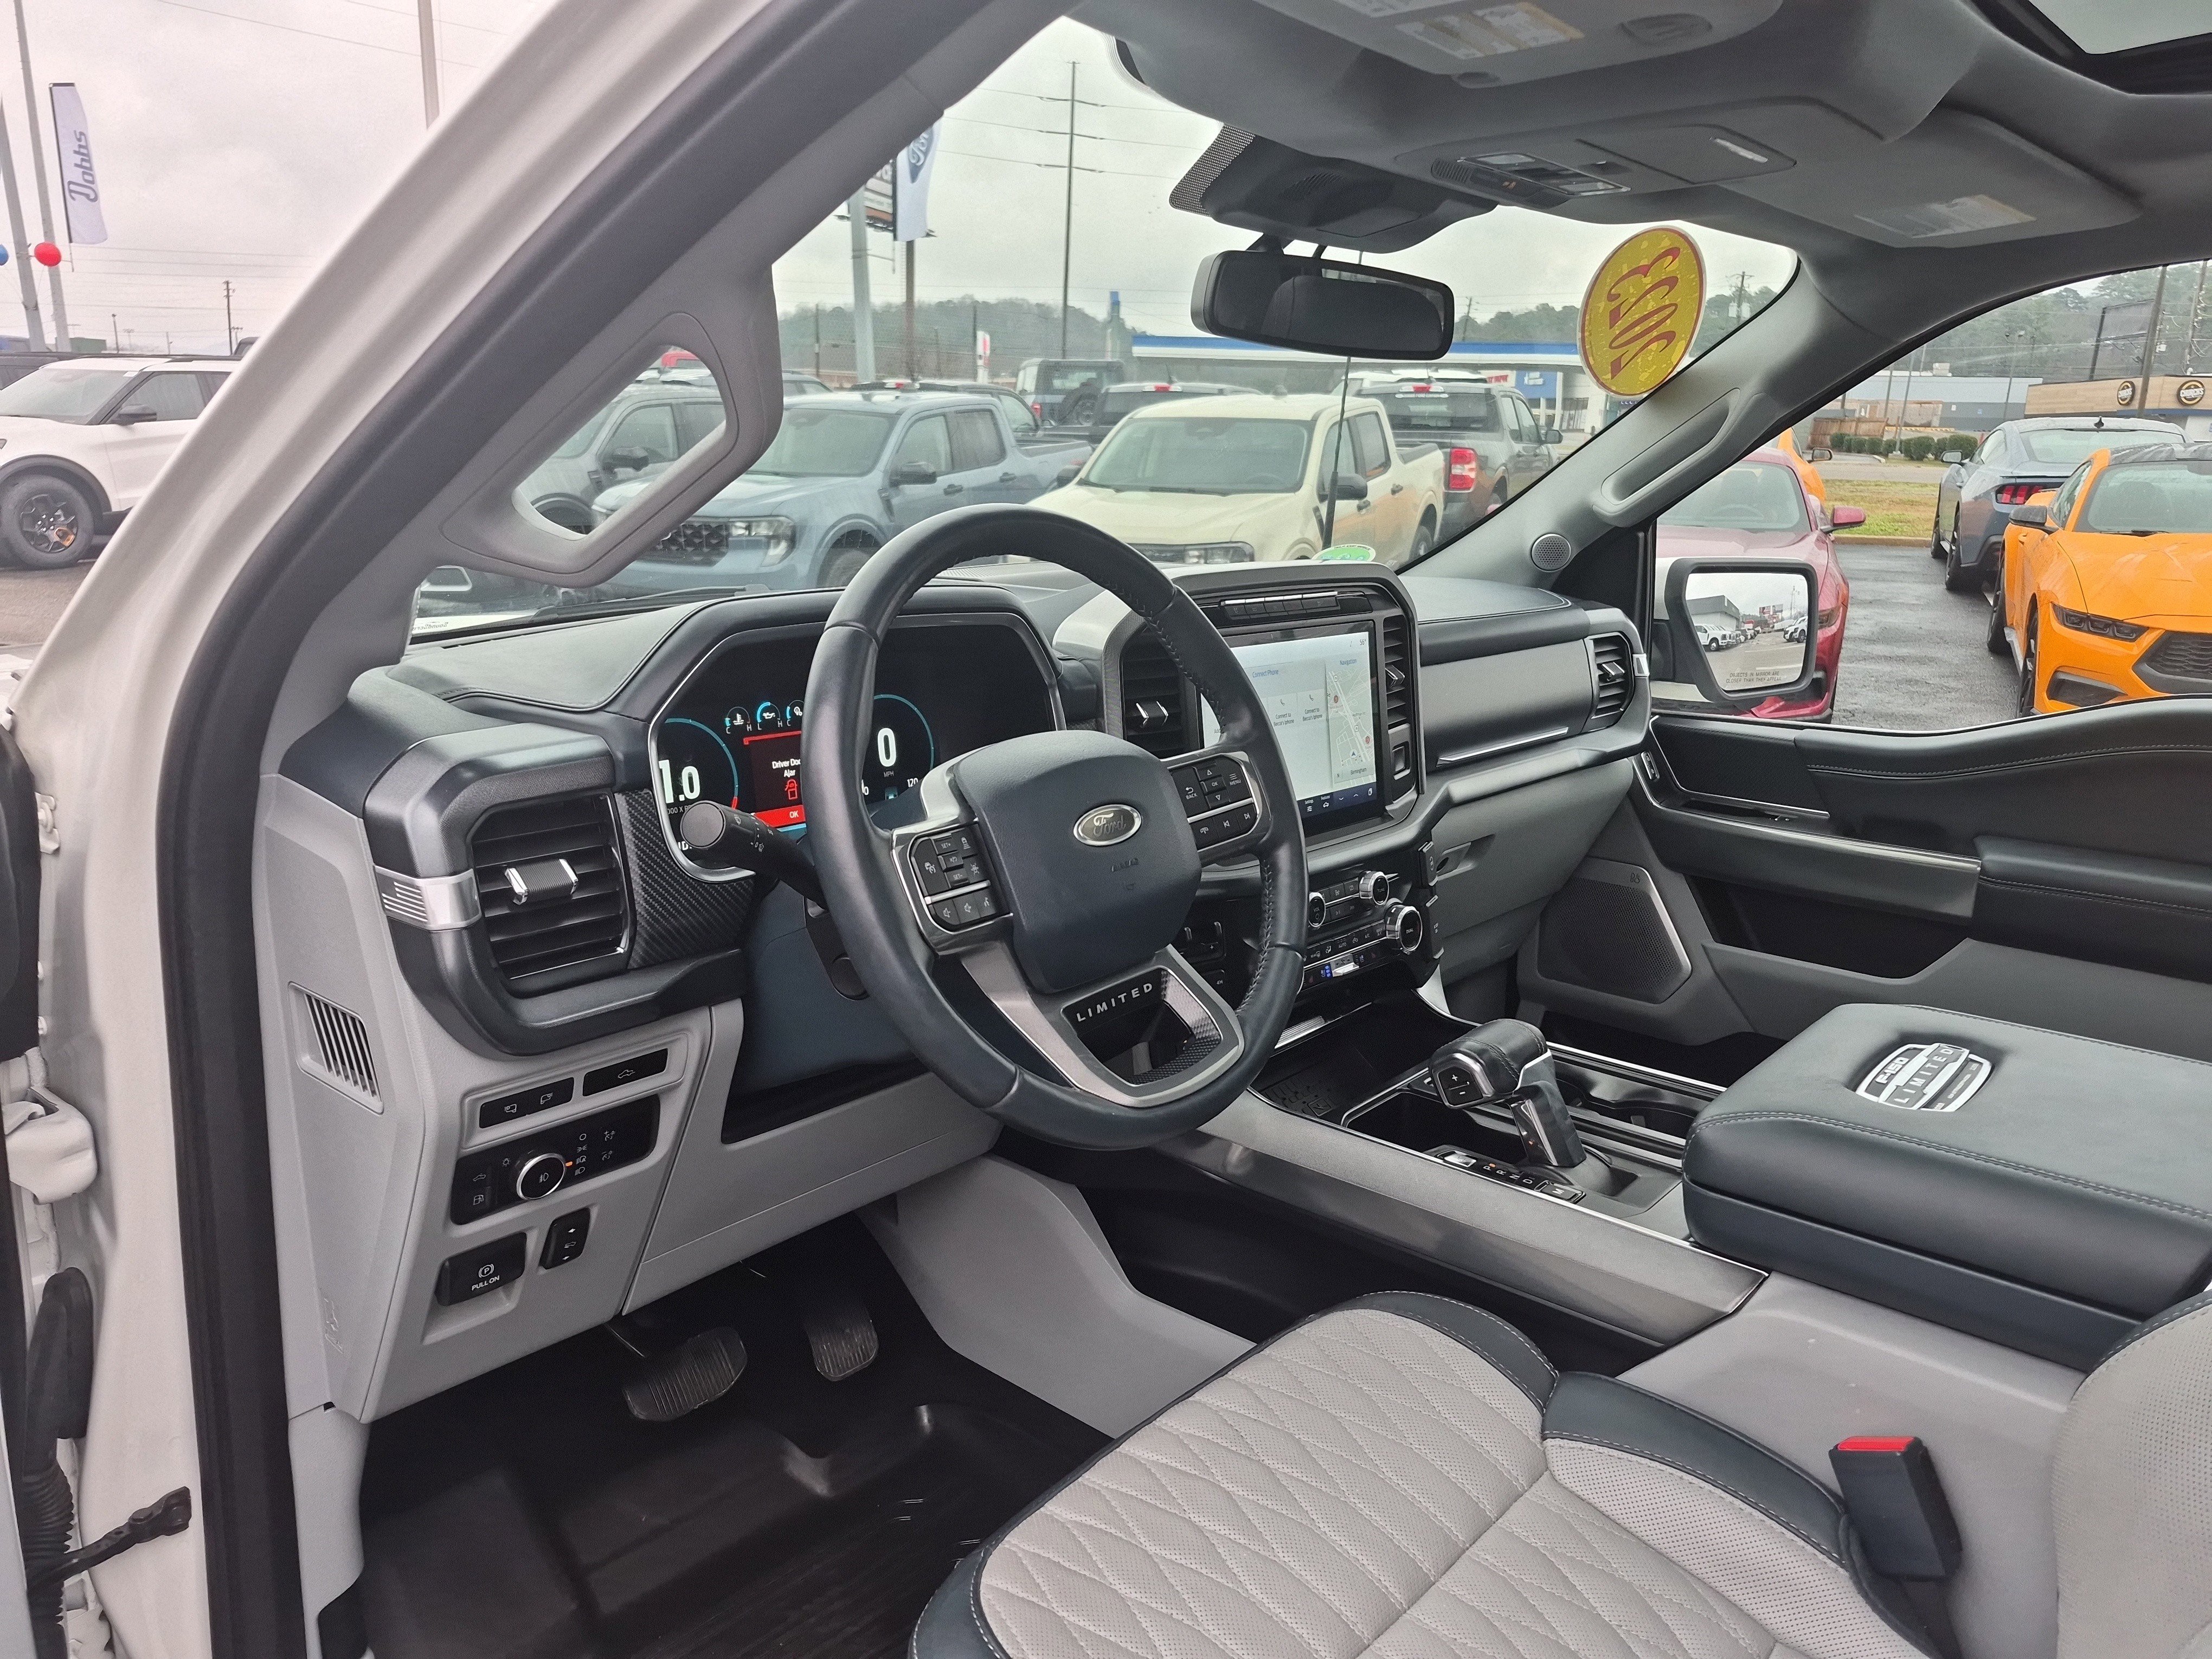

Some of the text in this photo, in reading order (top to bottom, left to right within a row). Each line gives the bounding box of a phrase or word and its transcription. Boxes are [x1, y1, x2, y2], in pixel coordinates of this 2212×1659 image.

[67, 130, 98, 203] Dobbs
[1252, 670, 1267, 678] Connect
[877, 728, 897, 767] 0
[771, 760, 790, 769] Driver
[783, 769, 796, 778] Ajar
[1351, 767, 1367, 775] Birmingham
[658, 759, 700, 803] 1.0
[789, 810, 800, 819] OK
[1093, 812, 1127, 837] Ford
[1076, 982, 1153, 1023] LIMITED
[1875, 1057, 1909, 1084] F-150
[1893, 1048, 1954, 1104] LIMITED
[472, 1275, 500, 1291] PULL ON
